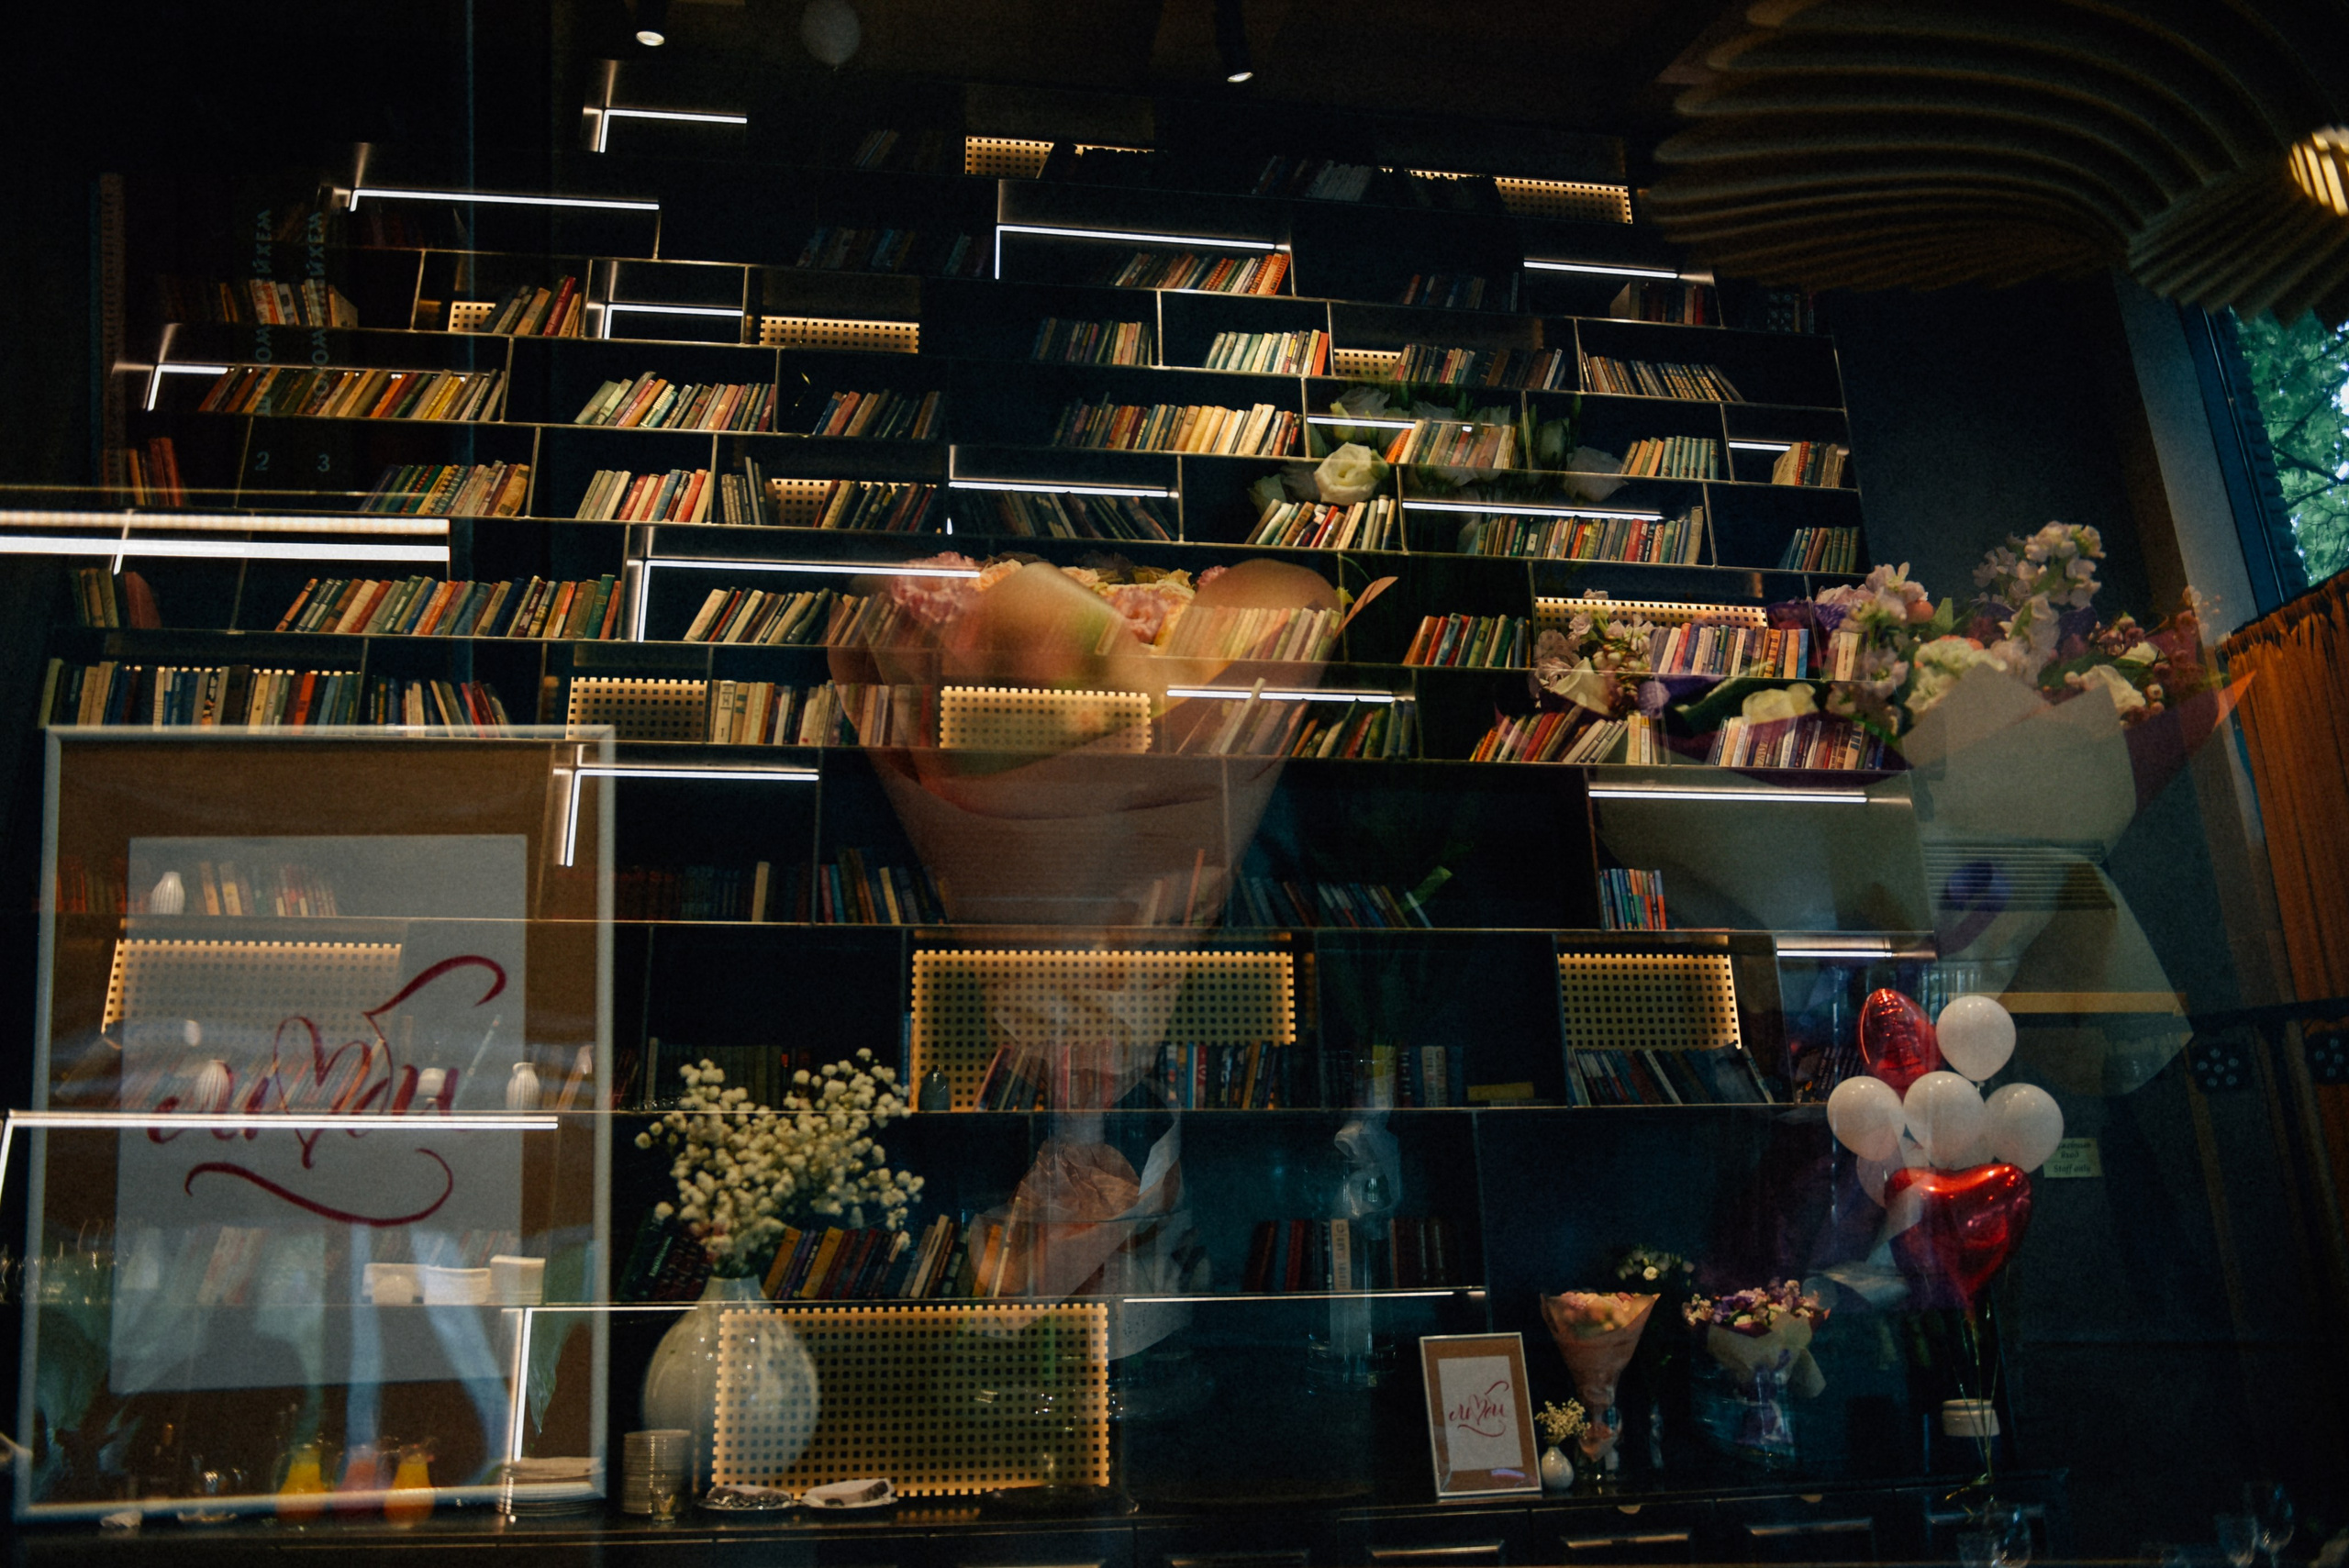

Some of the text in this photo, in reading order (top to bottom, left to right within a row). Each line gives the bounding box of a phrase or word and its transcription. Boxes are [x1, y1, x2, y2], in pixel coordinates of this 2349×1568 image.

[252, 209, 272, 317] ЙХЕМ
[255, 451, 270, 472] 2
[317, 454, 330, 472] 3
[2054, 1164, 2073, 1174] Staff
